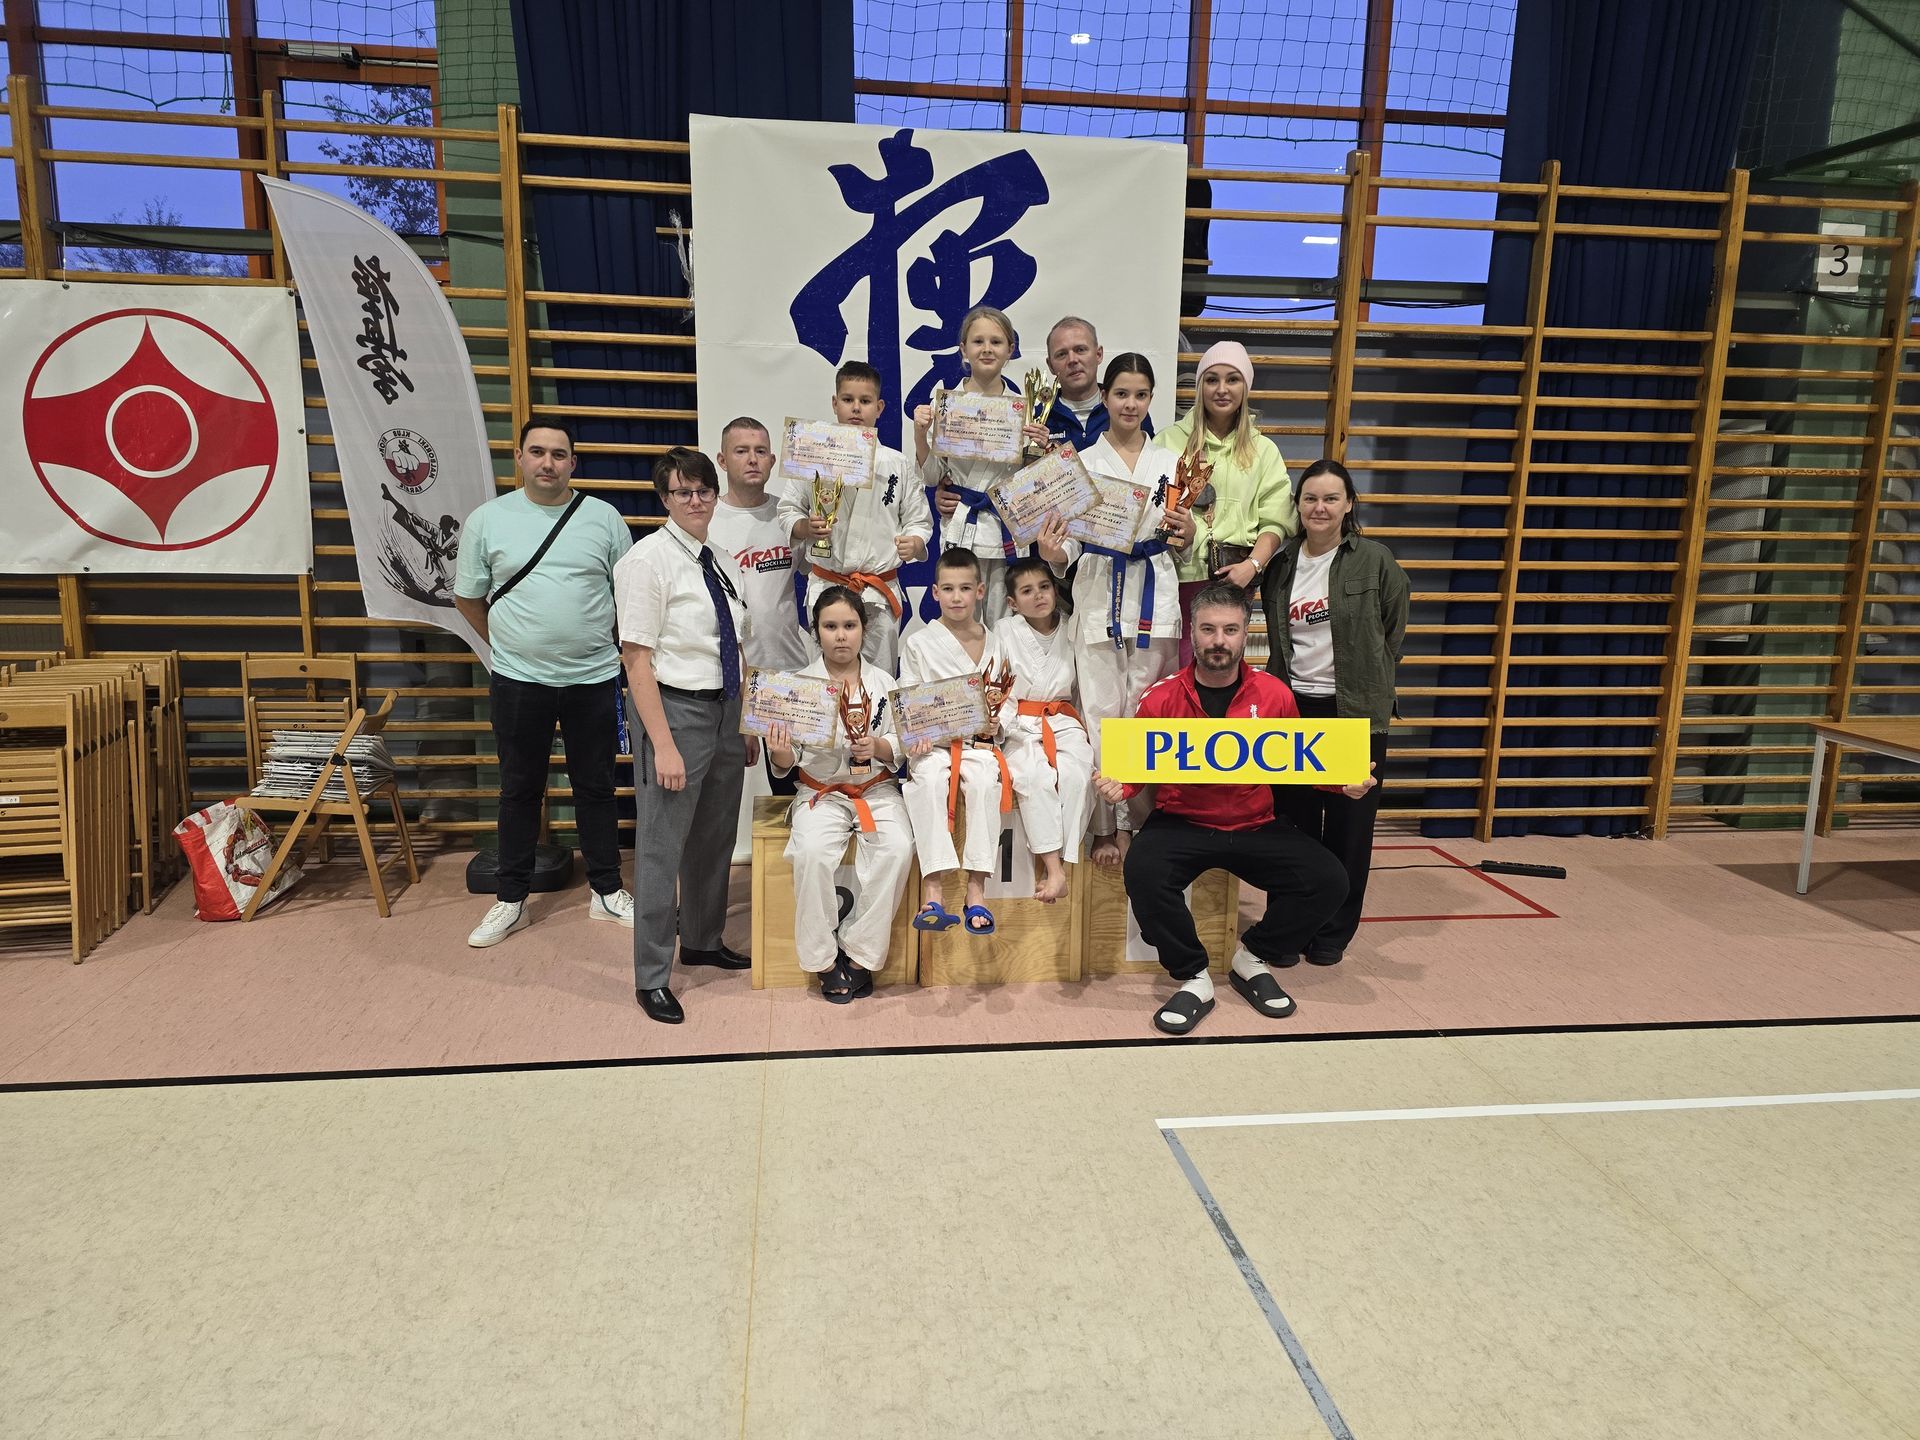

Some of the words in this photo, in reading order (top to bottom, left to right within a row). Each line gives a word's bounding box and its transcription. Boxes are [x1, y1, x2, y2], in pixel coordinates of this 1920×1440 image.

[1829, 244, 1850, 277] 3
[1048, 430, 1066, 440] mmel
[1145, 730, 1327, 772] PŁOCK
[998, 828, 1014, 883] 1
